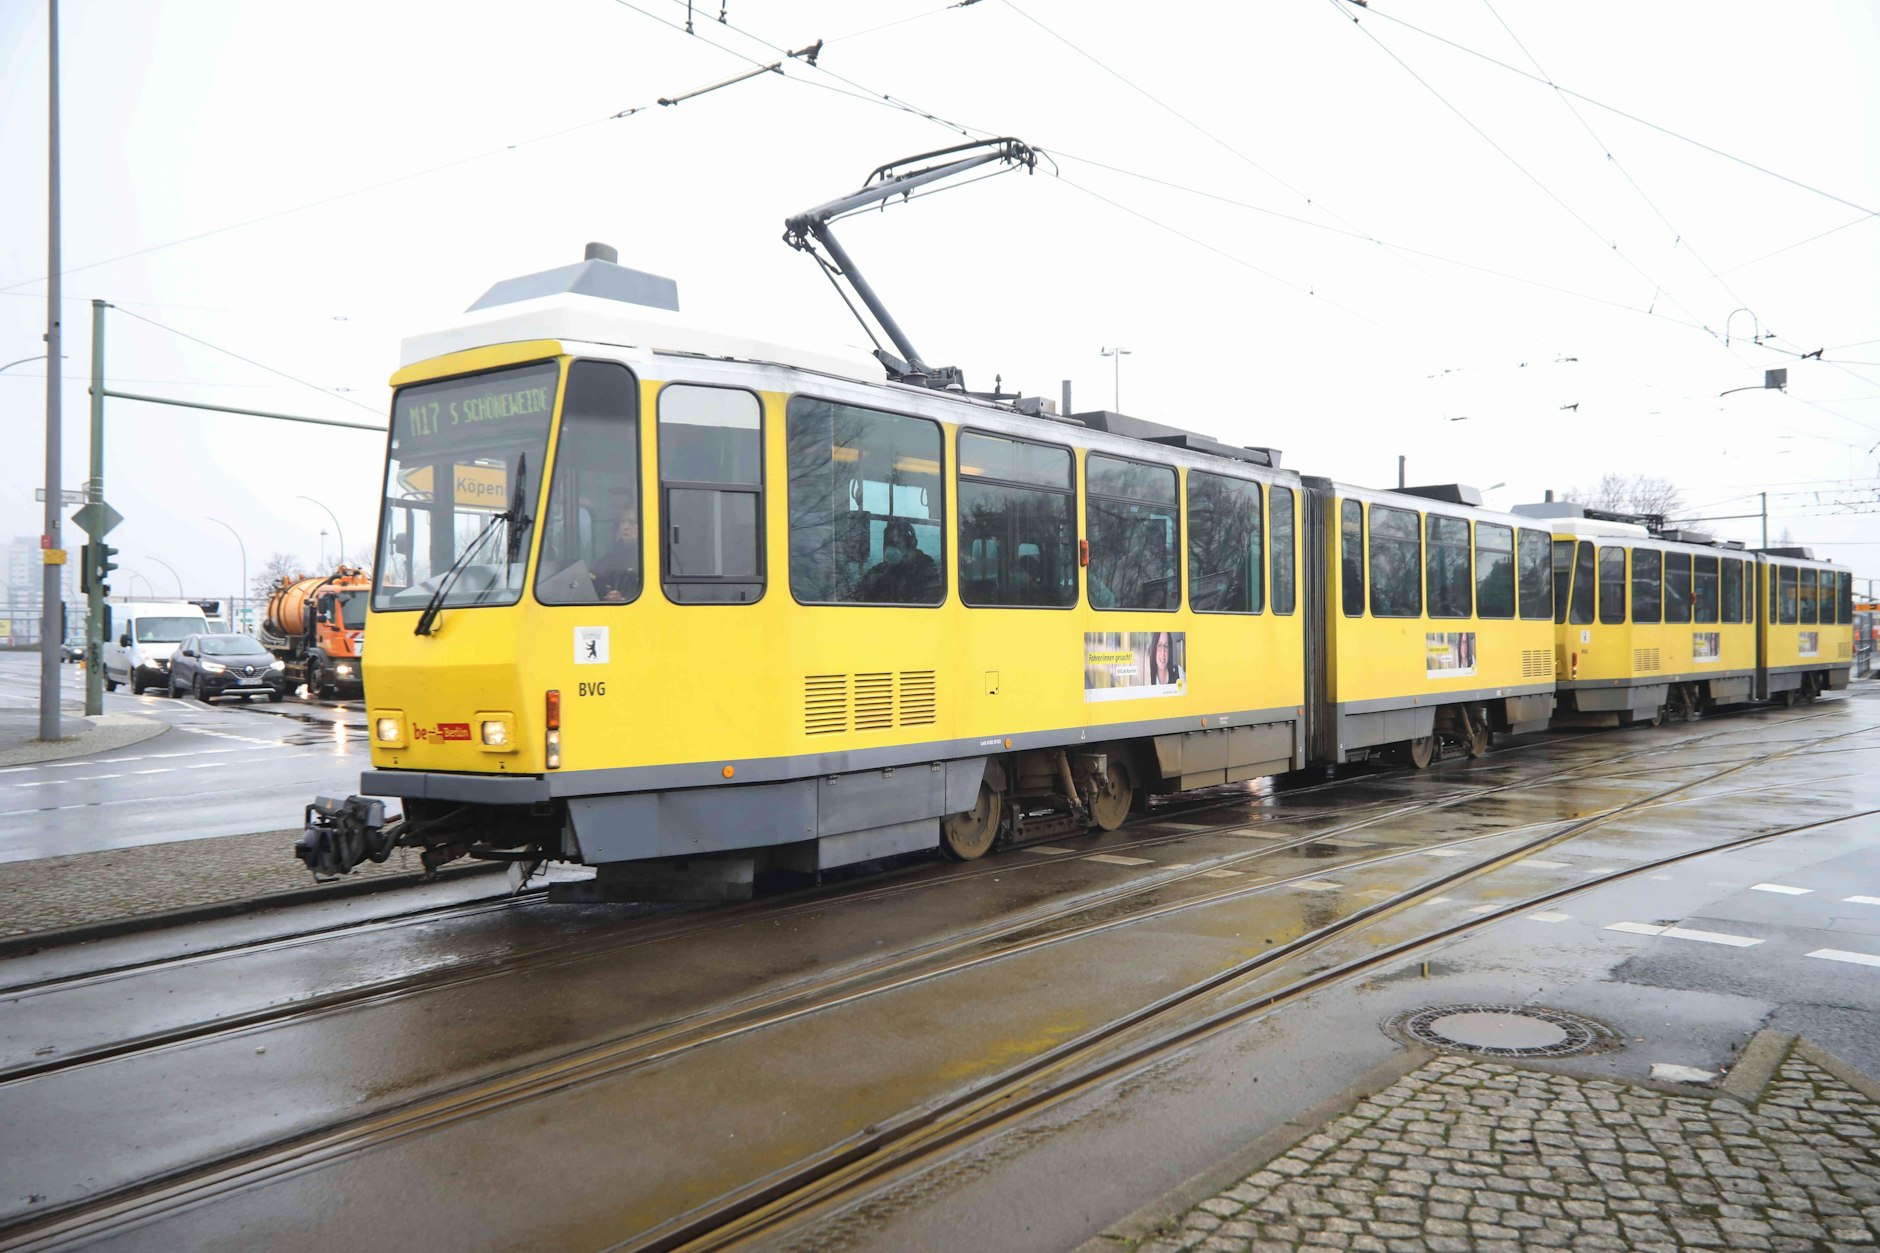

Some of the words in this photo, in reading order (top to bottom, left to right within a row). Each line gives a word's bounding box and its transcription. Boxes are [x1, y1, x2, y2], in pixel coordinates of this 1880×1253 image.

[409, 402, 439, 437] M17
[450, 402, 459, 425] S
[463, 387, 552, 423] SCHÖNEWEIDE
[578, 681, 605, 697] BVG
[412, 722, 428, 740] be
[443, 725, 469, 738] Berlin
